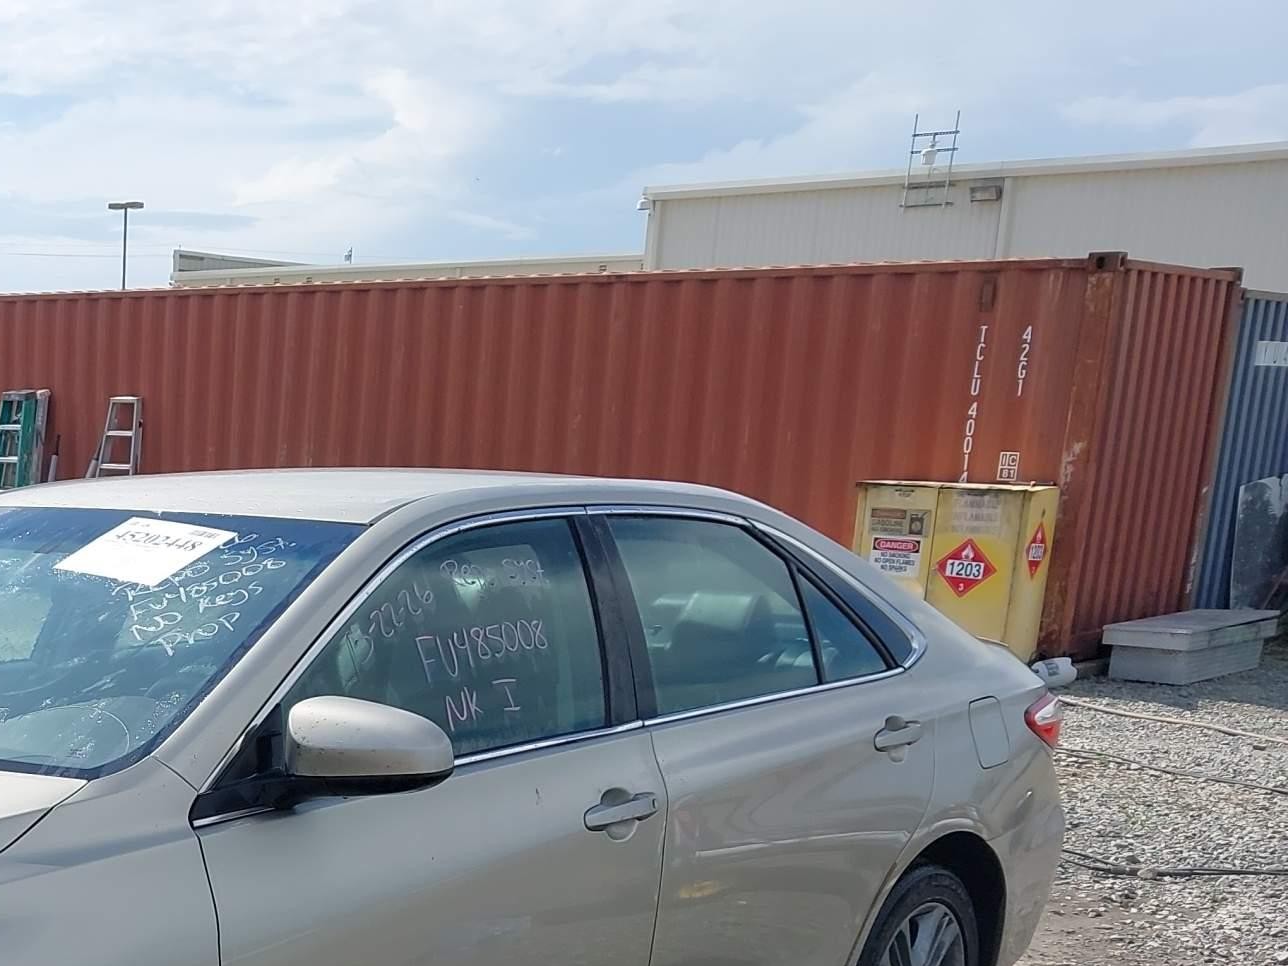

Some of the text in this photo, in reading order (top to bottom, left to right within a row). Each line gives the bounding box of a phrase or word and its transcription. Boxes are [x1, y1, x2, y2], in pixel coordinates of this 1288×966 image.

[971, 325, 988, 396] TCLU
[1017, 325, 1032, 397] 42G1
[879, 541, 914, 550] DANGER
[949, 562, 982, 578] 1203
[958, 583, 964, 591] 3
[415, 618, 548, 683] FU485008
